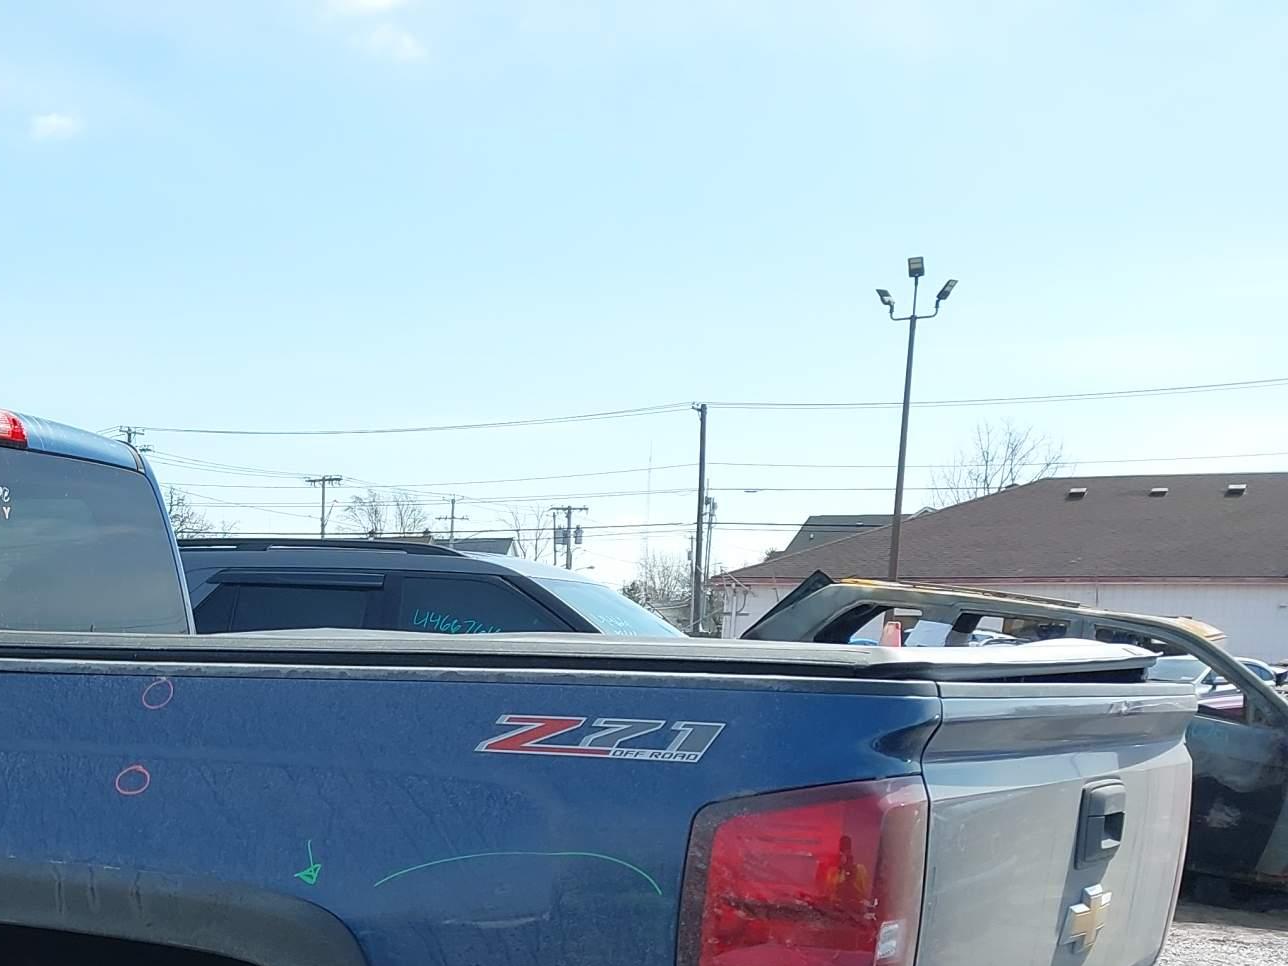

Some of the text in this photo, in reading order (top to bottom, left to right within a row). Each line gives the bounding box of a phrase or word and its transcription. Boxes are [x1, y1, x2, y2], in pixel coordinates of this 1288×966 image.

[474, 714, 726, 758] Z71
[612, 749, 699, 761] OFF ROAD
